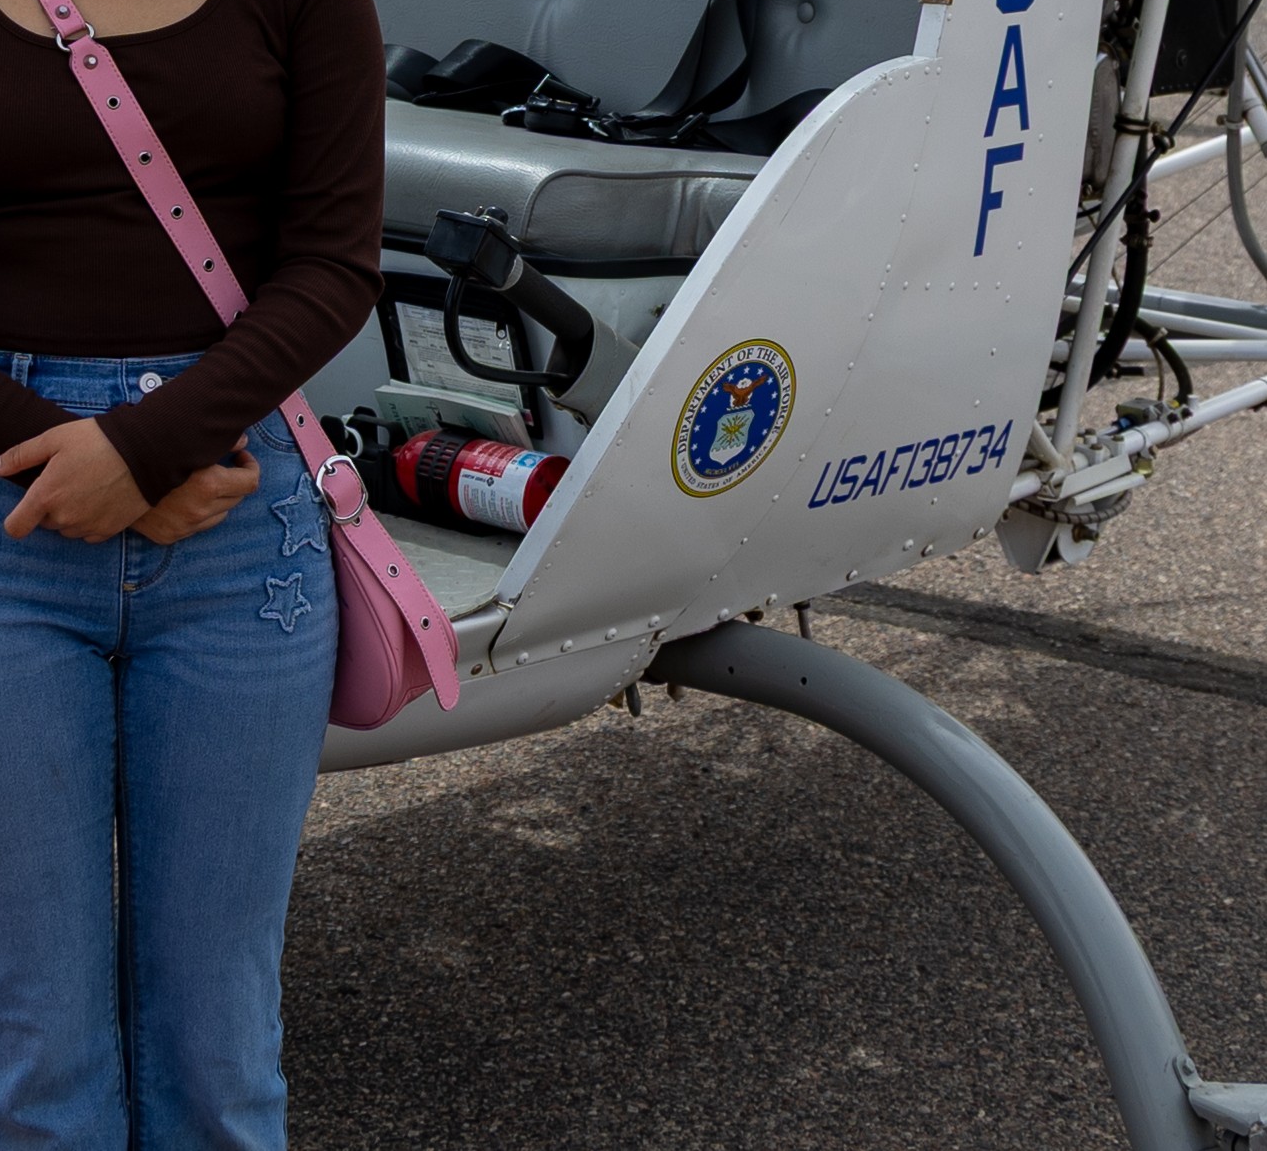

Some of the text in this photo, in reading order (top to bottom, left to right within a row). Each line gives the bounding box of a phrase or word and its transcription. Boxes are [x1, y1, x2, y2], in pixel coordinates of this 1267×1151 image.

[678, 347, 792, 455] DEPARTMENT OF THE AIR FORCE
[680, 462, 696, 486] UNITED
[696, 480, 720, 490] STATES
[722, 476, 733, 486] OF
[736, 445, 768, 478] AMERICA
[807, 419, 1014, 510] USAF138734
